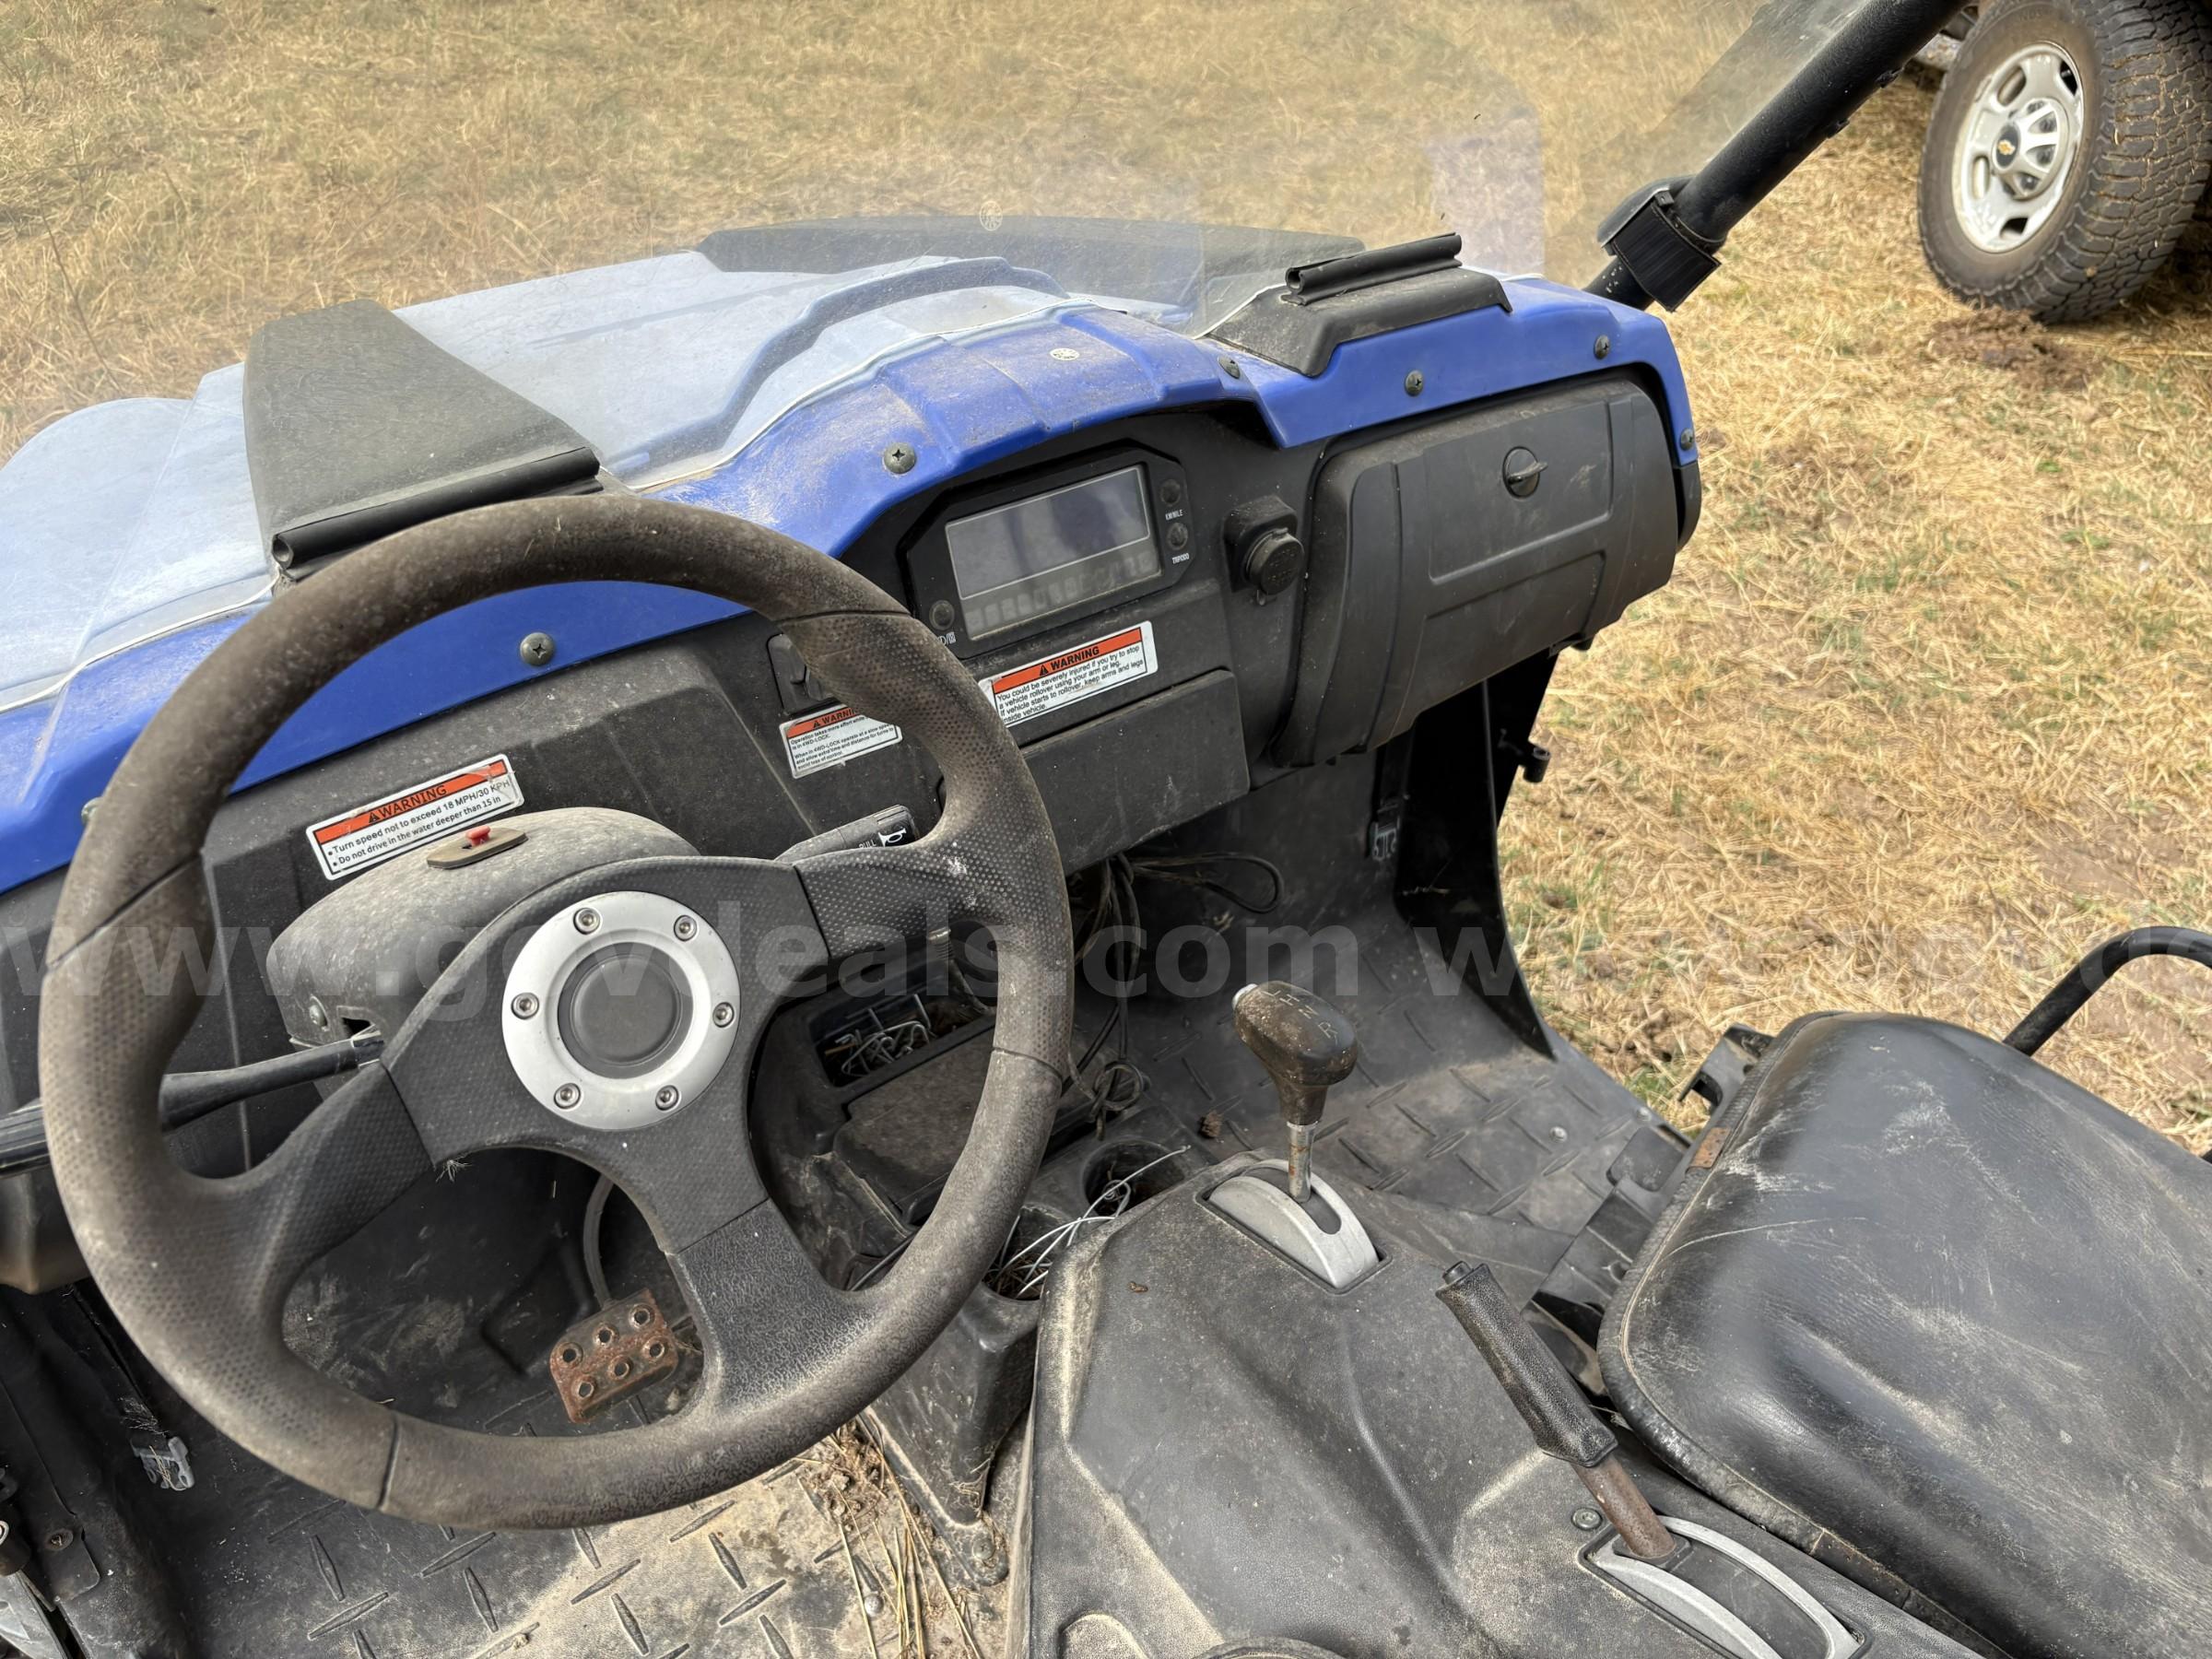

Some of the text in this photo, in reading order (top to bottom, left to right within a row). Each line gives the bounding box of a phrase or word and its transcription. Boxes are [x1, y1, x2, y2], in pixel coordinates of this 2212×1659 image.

[1011, 685, 1030, 696] could
[1041, 672, 1068, 688] severely
[1069, 663, 1090, 676] injured
[1097, 657, 1109, 667] you
[1109, 653, 1119, 662] try
[1126, 645, 1140, 655] stop
[1050, 646, 1100, 671] WARNING
[1005, 693, 1029, 707] vehicle
[1030, 686, 1053, 699] rollover
[1054, 677, 1073, 690] using
[1073, 672, 1088, 683] your
[1088, 667, 1101, 677] arm
[1101, 664, 1111, 672] or
[1110, 660, 1122, 669] leg.
[1006, 700, 1030, 714] vehicle
[1030, 694, 1050, 706] starts
[1084, 674, 1100, 686] keep
[1100, 669, 1117, 679] arms
[1118, 664, 1130, 674] and
[1130, 659, 1144, 669] legs
[1004, 703, 1048, 724] nside vehicle.
[814, 740, 841, 752] 4WD-LOCK
[332, 781, 511, 853] Turn speed not to exceed 18 MPH/30 KPH
[378, 784, 447, 818] WARNING
[338, 795, 501, 865] Do not drive in the water deeper than 15 in
[1317, 1021, 1338, 1039] R
